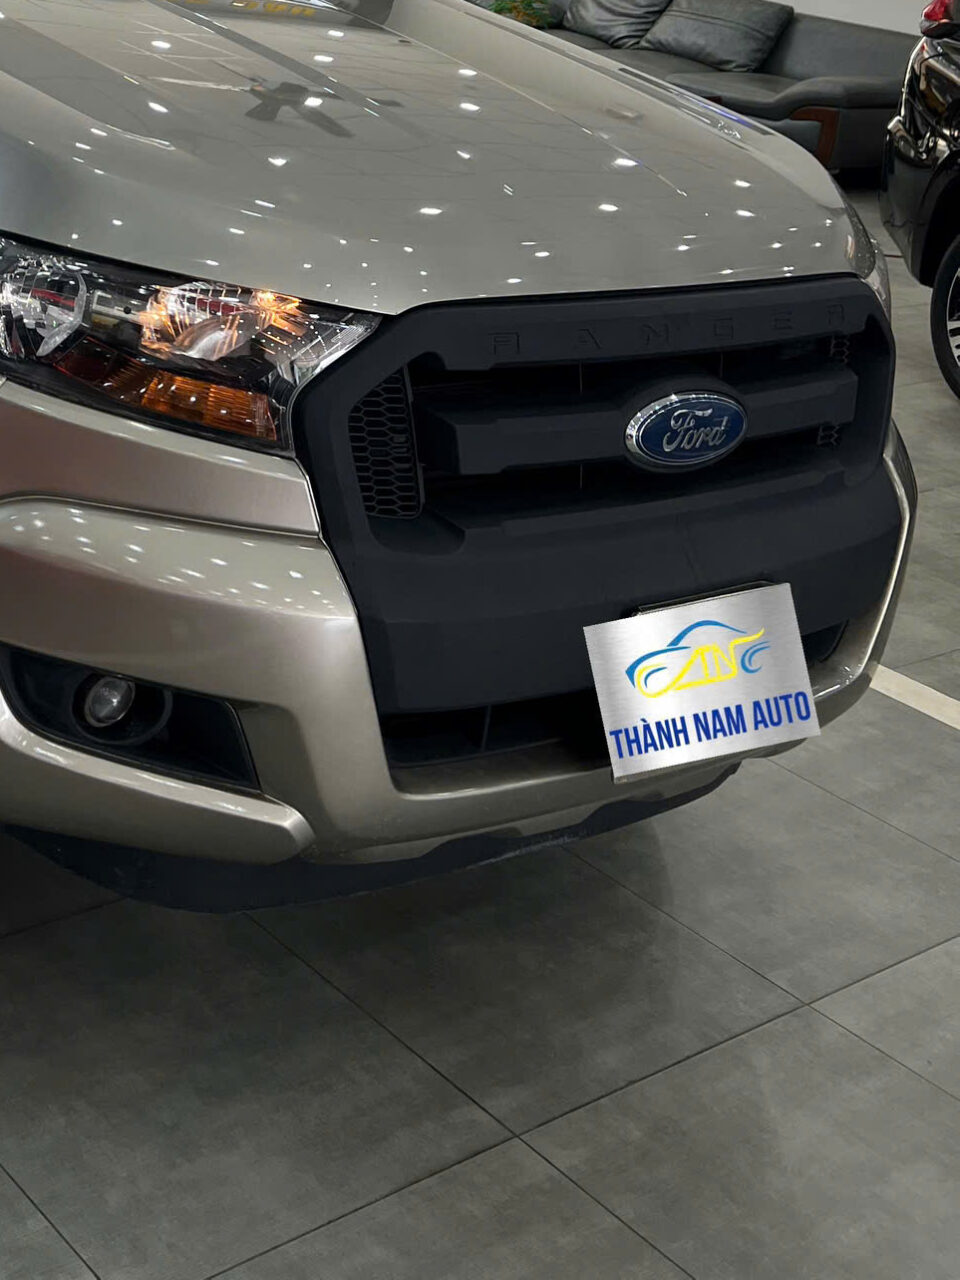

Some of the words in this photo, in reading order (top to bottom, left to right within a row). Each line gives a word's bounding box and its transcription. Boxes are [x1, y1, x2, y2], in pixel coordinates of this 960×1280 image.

[662, 408, 729, 452] Ford
[610, 716, 690, 759] THÀNH
[693, 704, 748, 743] NAM
[753, 691, 811, 731] AUTO
